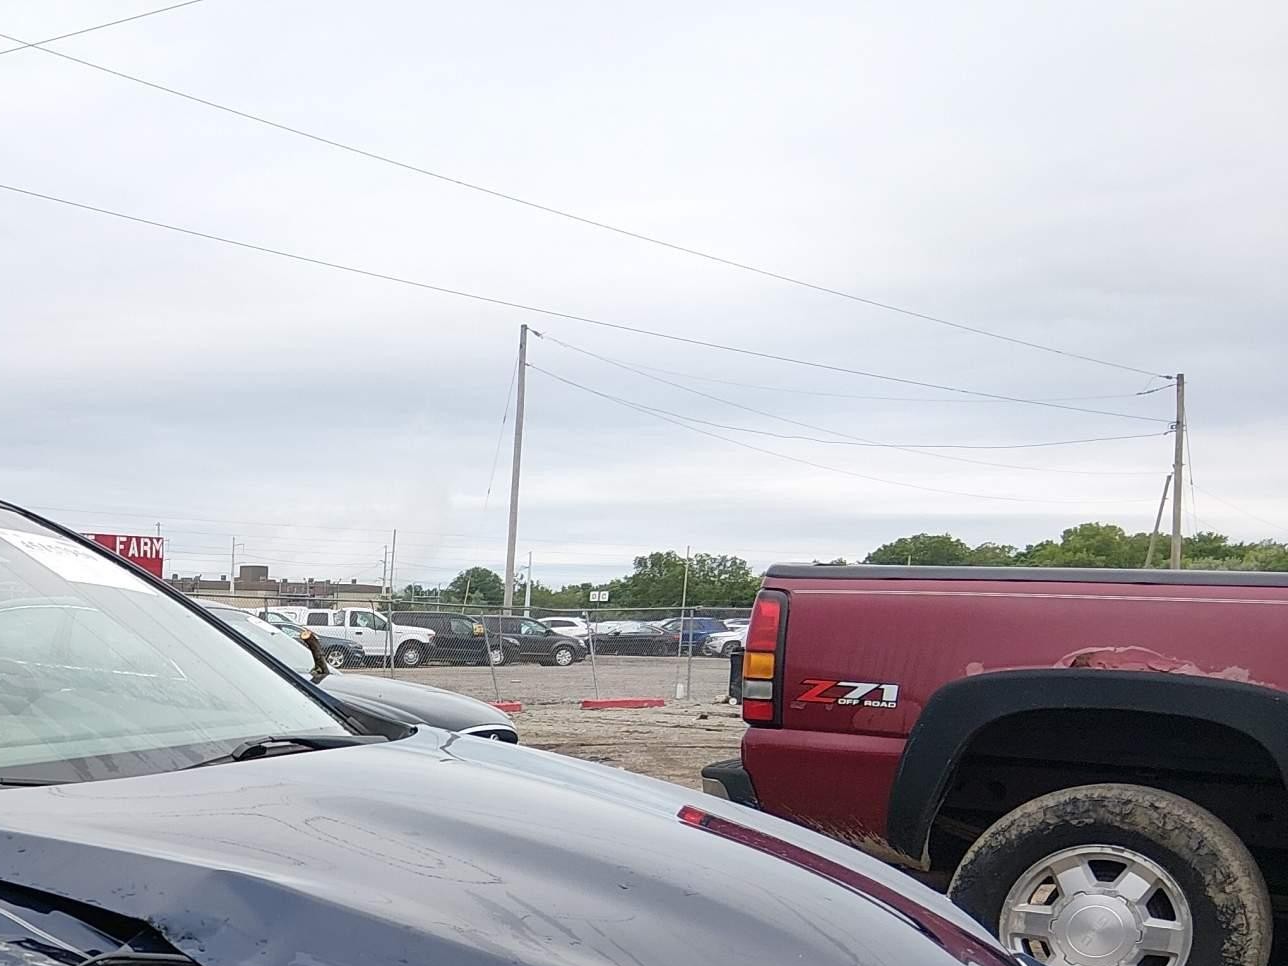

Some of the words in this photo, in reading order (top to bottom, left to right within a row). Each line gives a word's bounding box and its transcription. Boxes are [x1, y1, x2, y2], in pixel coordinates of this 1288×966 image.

[116, 536, 163, 558] FARM
[795, 679, 899, 703] Z71
[838, 698, 859, 706] OFF
[863, 700, 897, 708] ROAD
